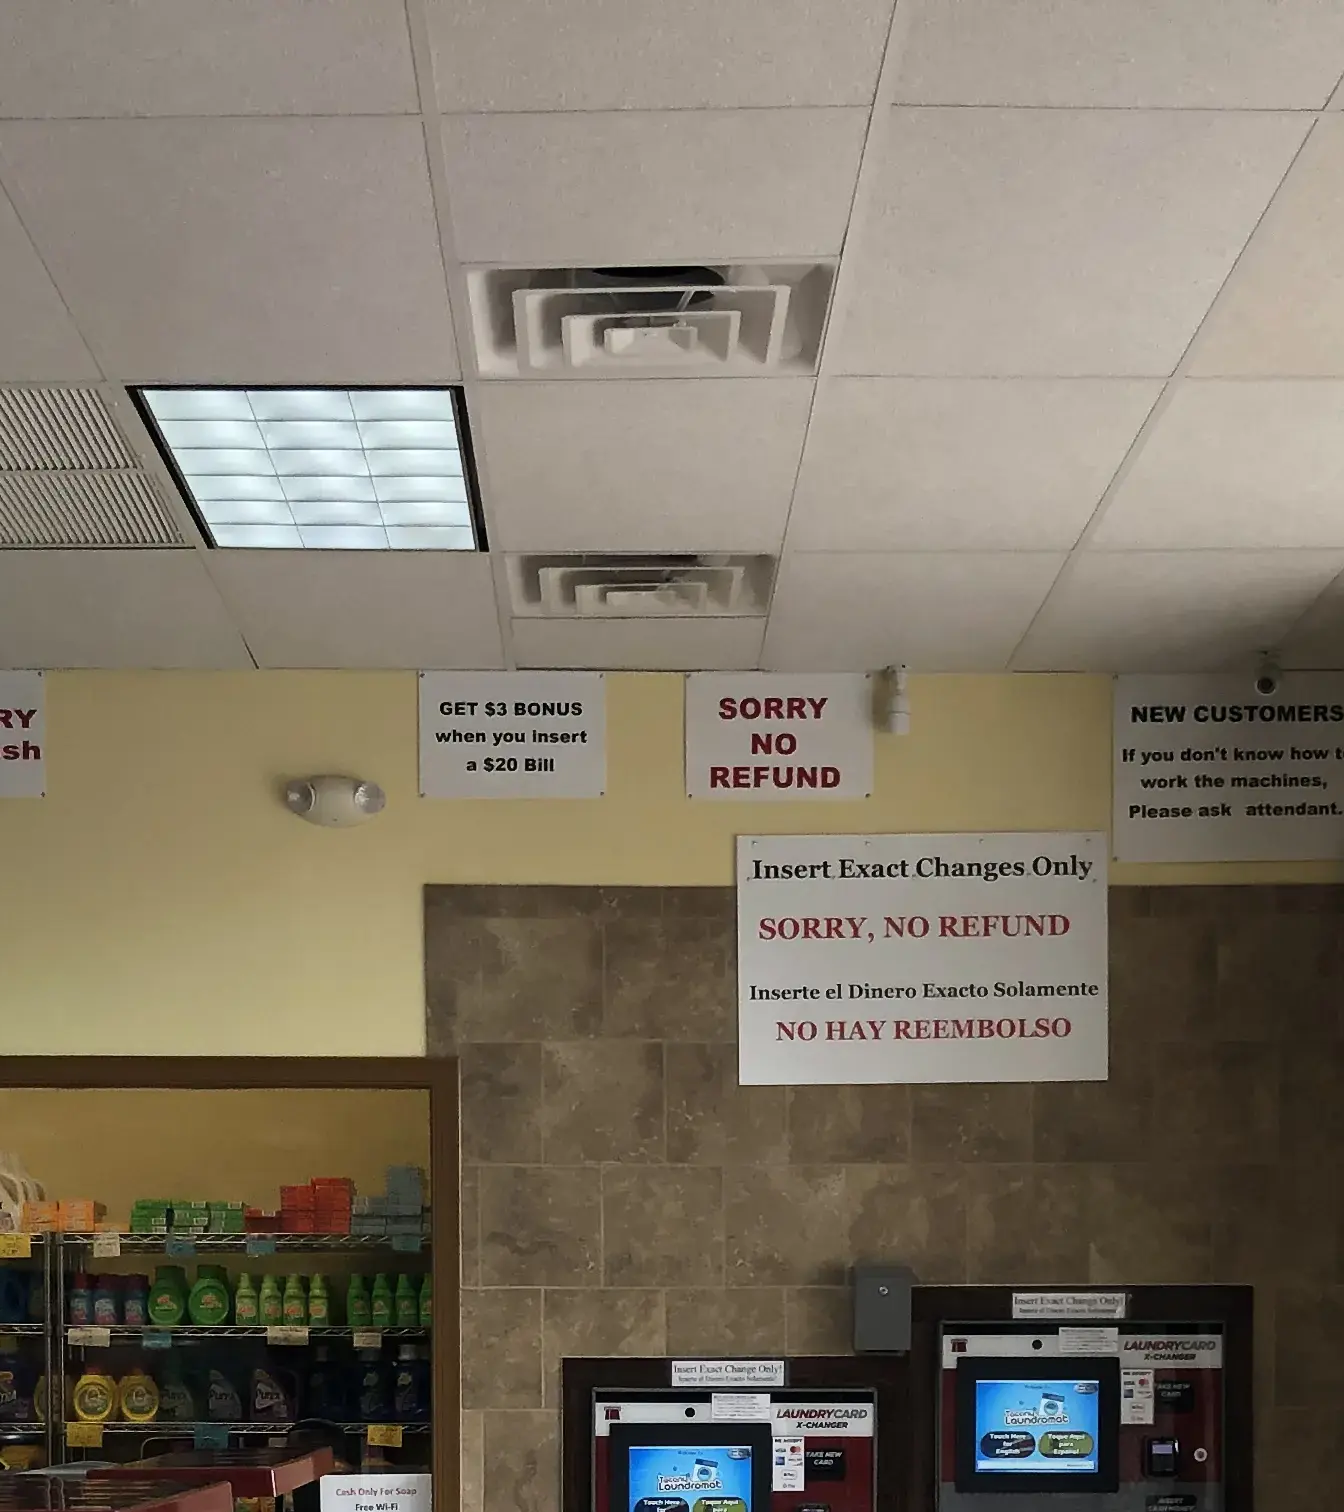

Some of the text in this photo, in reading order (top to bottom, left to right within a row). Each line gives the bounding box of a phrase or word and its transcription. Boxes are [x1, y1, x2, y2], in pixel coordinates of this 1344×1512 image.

[439, 701, 583, 718] GET $3 BONUS
[718, 698, 828, 720] SORRY
[1131, 705, 1344, 722] NEW CUSTOMERS
[435, 729, 486, 743] when
[492, 731, 525, 747] you
[751, 733, 797, 755] NO
[1122, 749, 1135, 762] If
[1140, 751, 1174, 765] you
[1180, 747, 1227, 761] don't
[1234, 748, 1284, 761] know
[1291, 747, 1328, 760] how
[466, 757, 555, 773] a $20 Bill
[710, 766, 841, 788] REFUND
[1140, 775, 1188, 789] work
[1194, 775, 1225, 788] the
[1129, 802, 1344, 818] Please ask attendant.
[752, 855, 1093, 882] Insert Exact Changes Only
[759, 914, 1070, 943] SORRY, NO REFUND
[749, 981, 1099, 1001] Inserte el Dinero Exacto Solamente
[776, 1018, 1071, 1041] NO HAY REEMBOLSO
[1124, 1341, 1216, 1350] LAUNDRYCARD
[674, 1365, 697, 1373] Insert
[700, 1365, 723, 1373] Exact
[725, 1365, 756, 1375] Change
[776, 1409, 868, 1419] LAUNDRYCARD
[1005, 1415, 1069, 1425] Laundromat
[336, 1488, 356, 1496] Cash
[358, 1488, 378, 1496] Only
[395, 1488, 417, 1497] Soap
[658, 1480, 722, 1491] Laundromat
[376, 1503, 398, 1511] Wi-Fi
